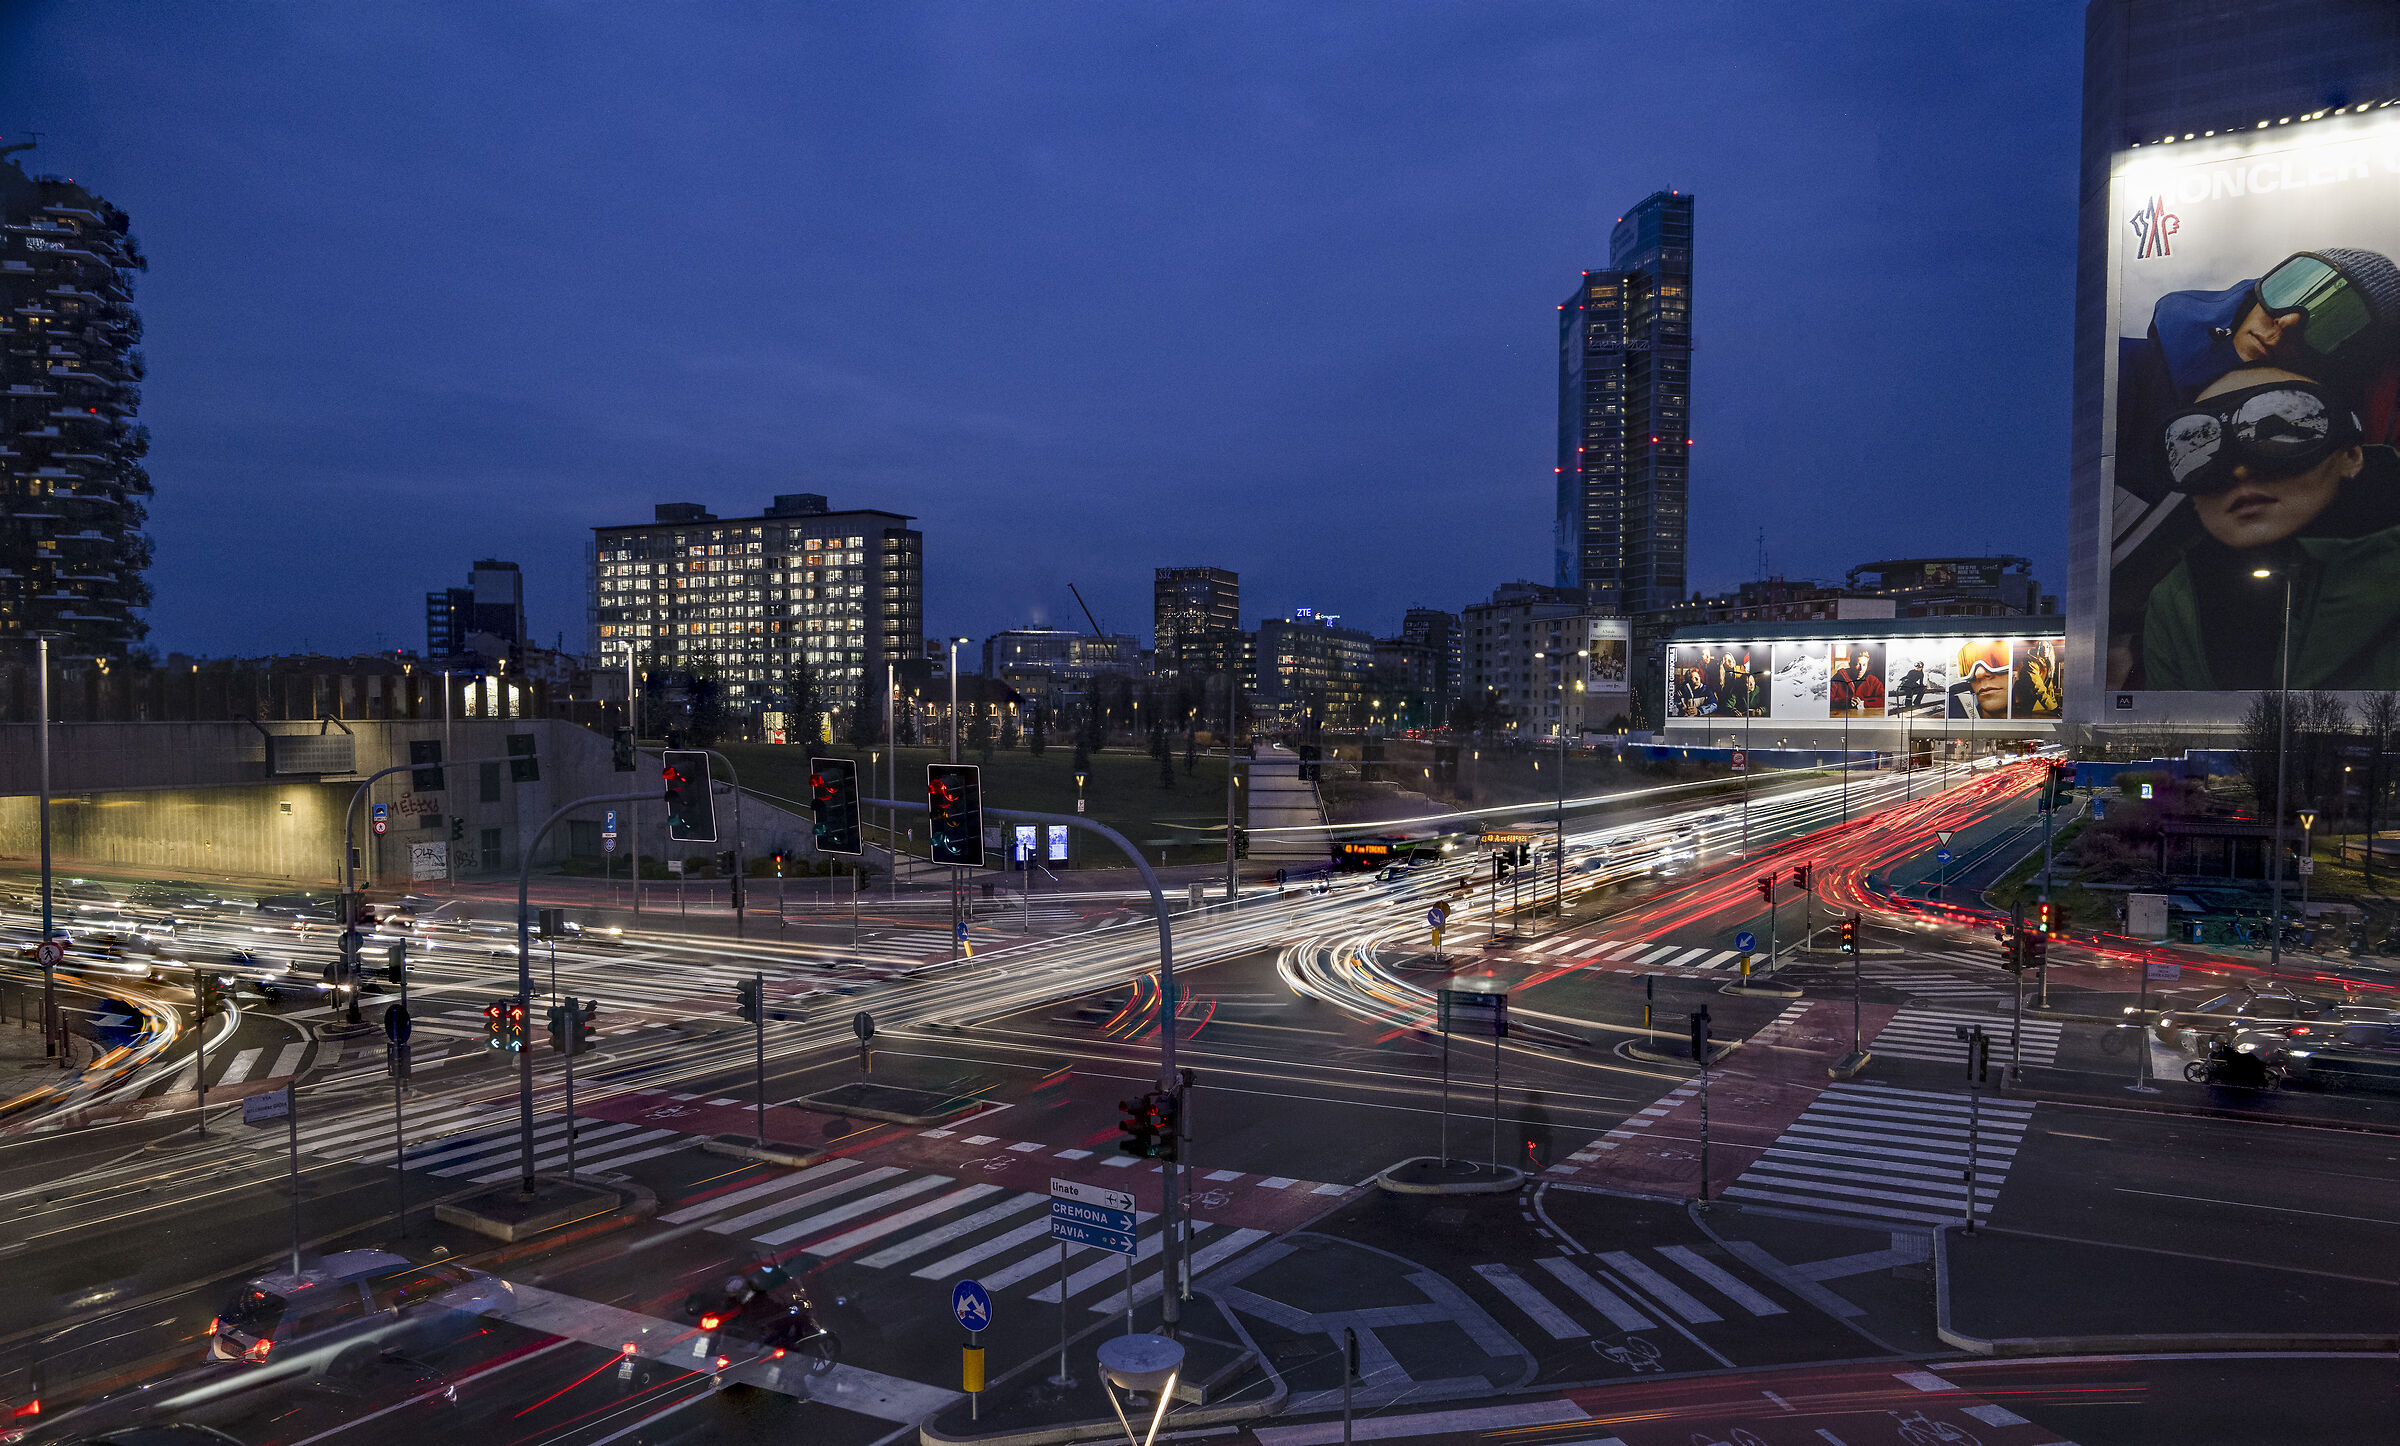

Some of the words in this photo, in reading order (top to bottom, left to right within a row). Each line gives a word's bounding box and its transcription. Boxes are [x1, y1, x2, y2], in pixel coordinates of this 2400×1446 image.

[1296, 608, 1312, 617] ZTE
[1053, 1203, 1108, 1224] CREMONA
[1053, 1223, 1084, 1239] PAVIA
